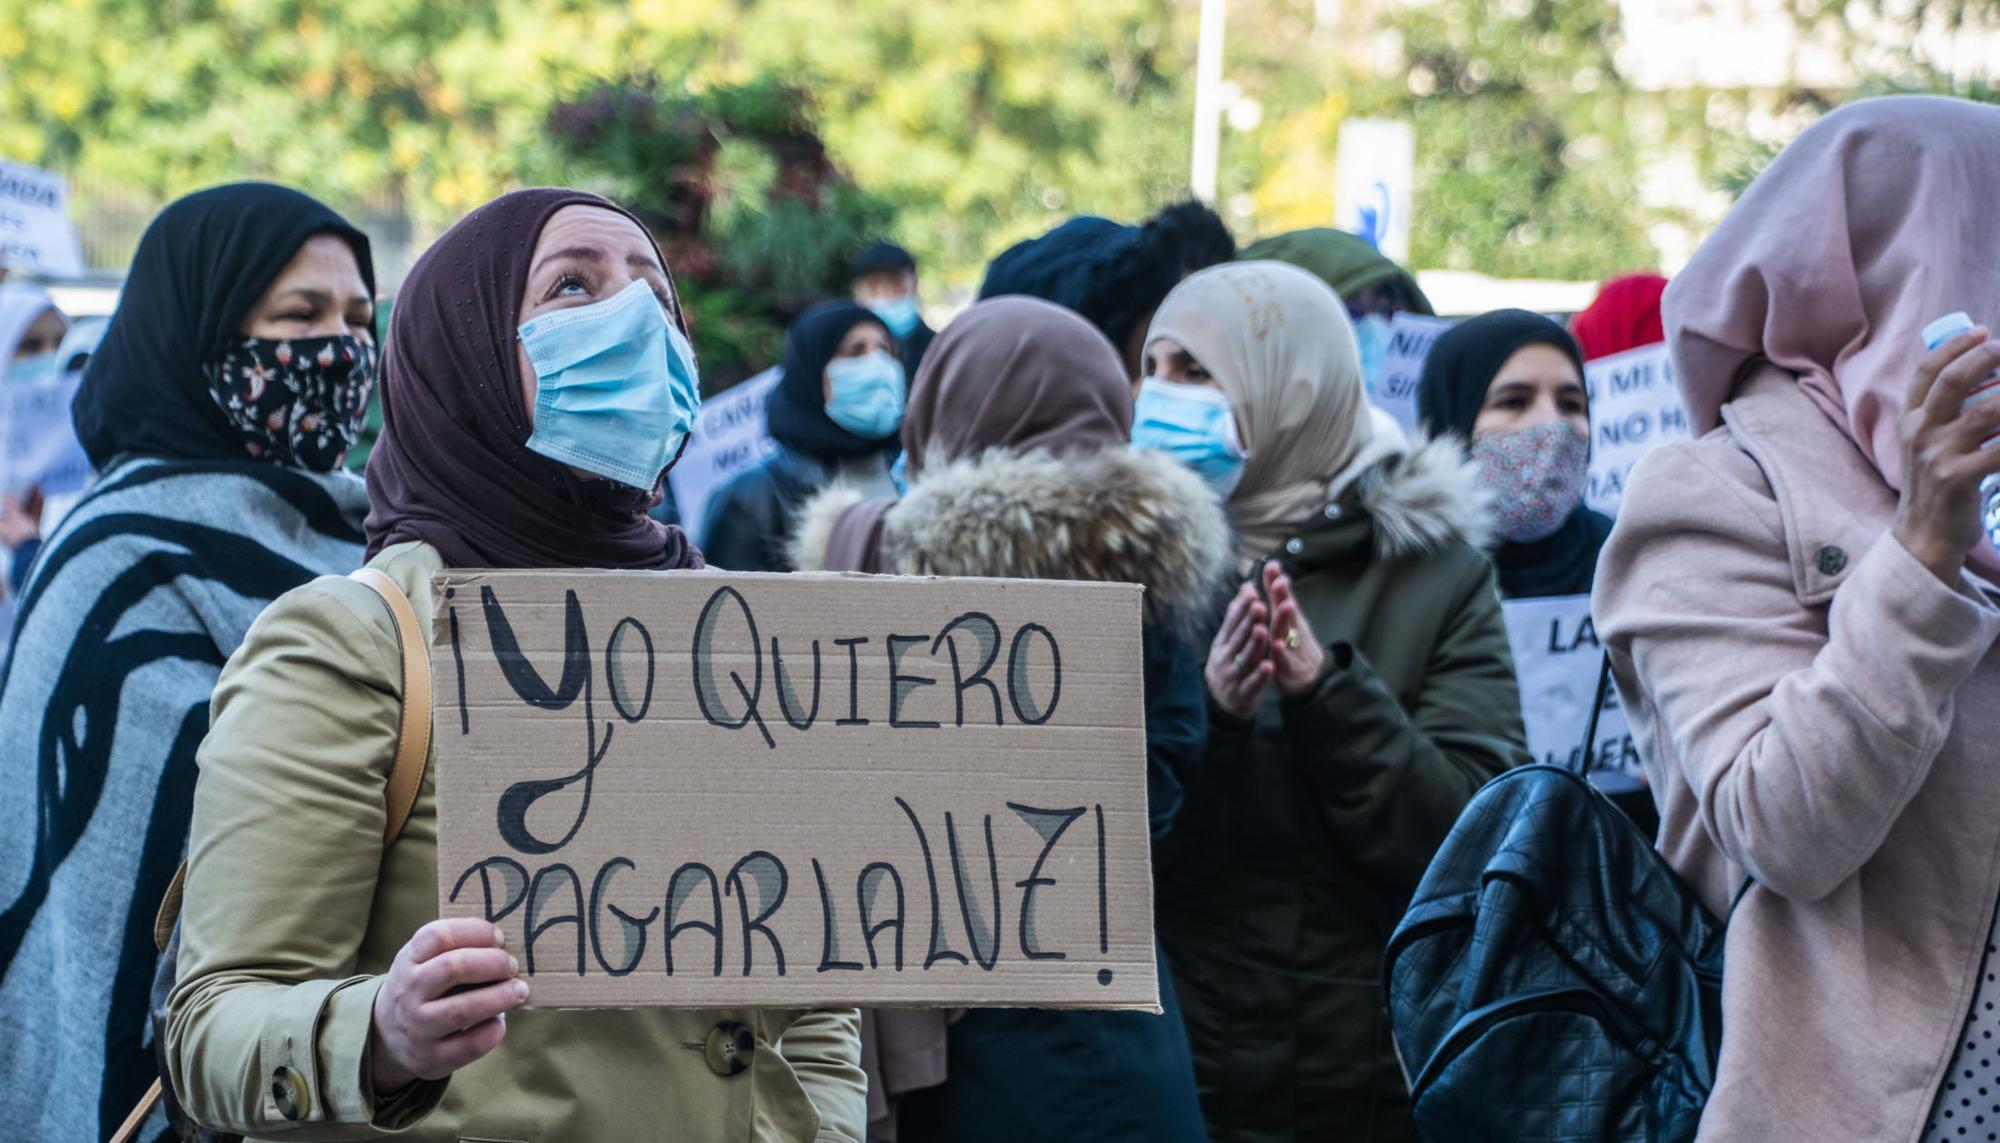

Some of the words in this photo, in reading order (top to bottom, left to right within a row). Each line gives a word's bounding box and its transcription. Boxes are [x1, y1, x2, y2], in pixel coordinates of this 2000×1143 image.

[1600, 412, 1650, 448] NO
[692, 586, 1061, 749] QUIERO
[450, 851, 789, 977] PAGAR
[811, 858, 905, 972] LA
[894, 796, 1113, 986] LUZ!
